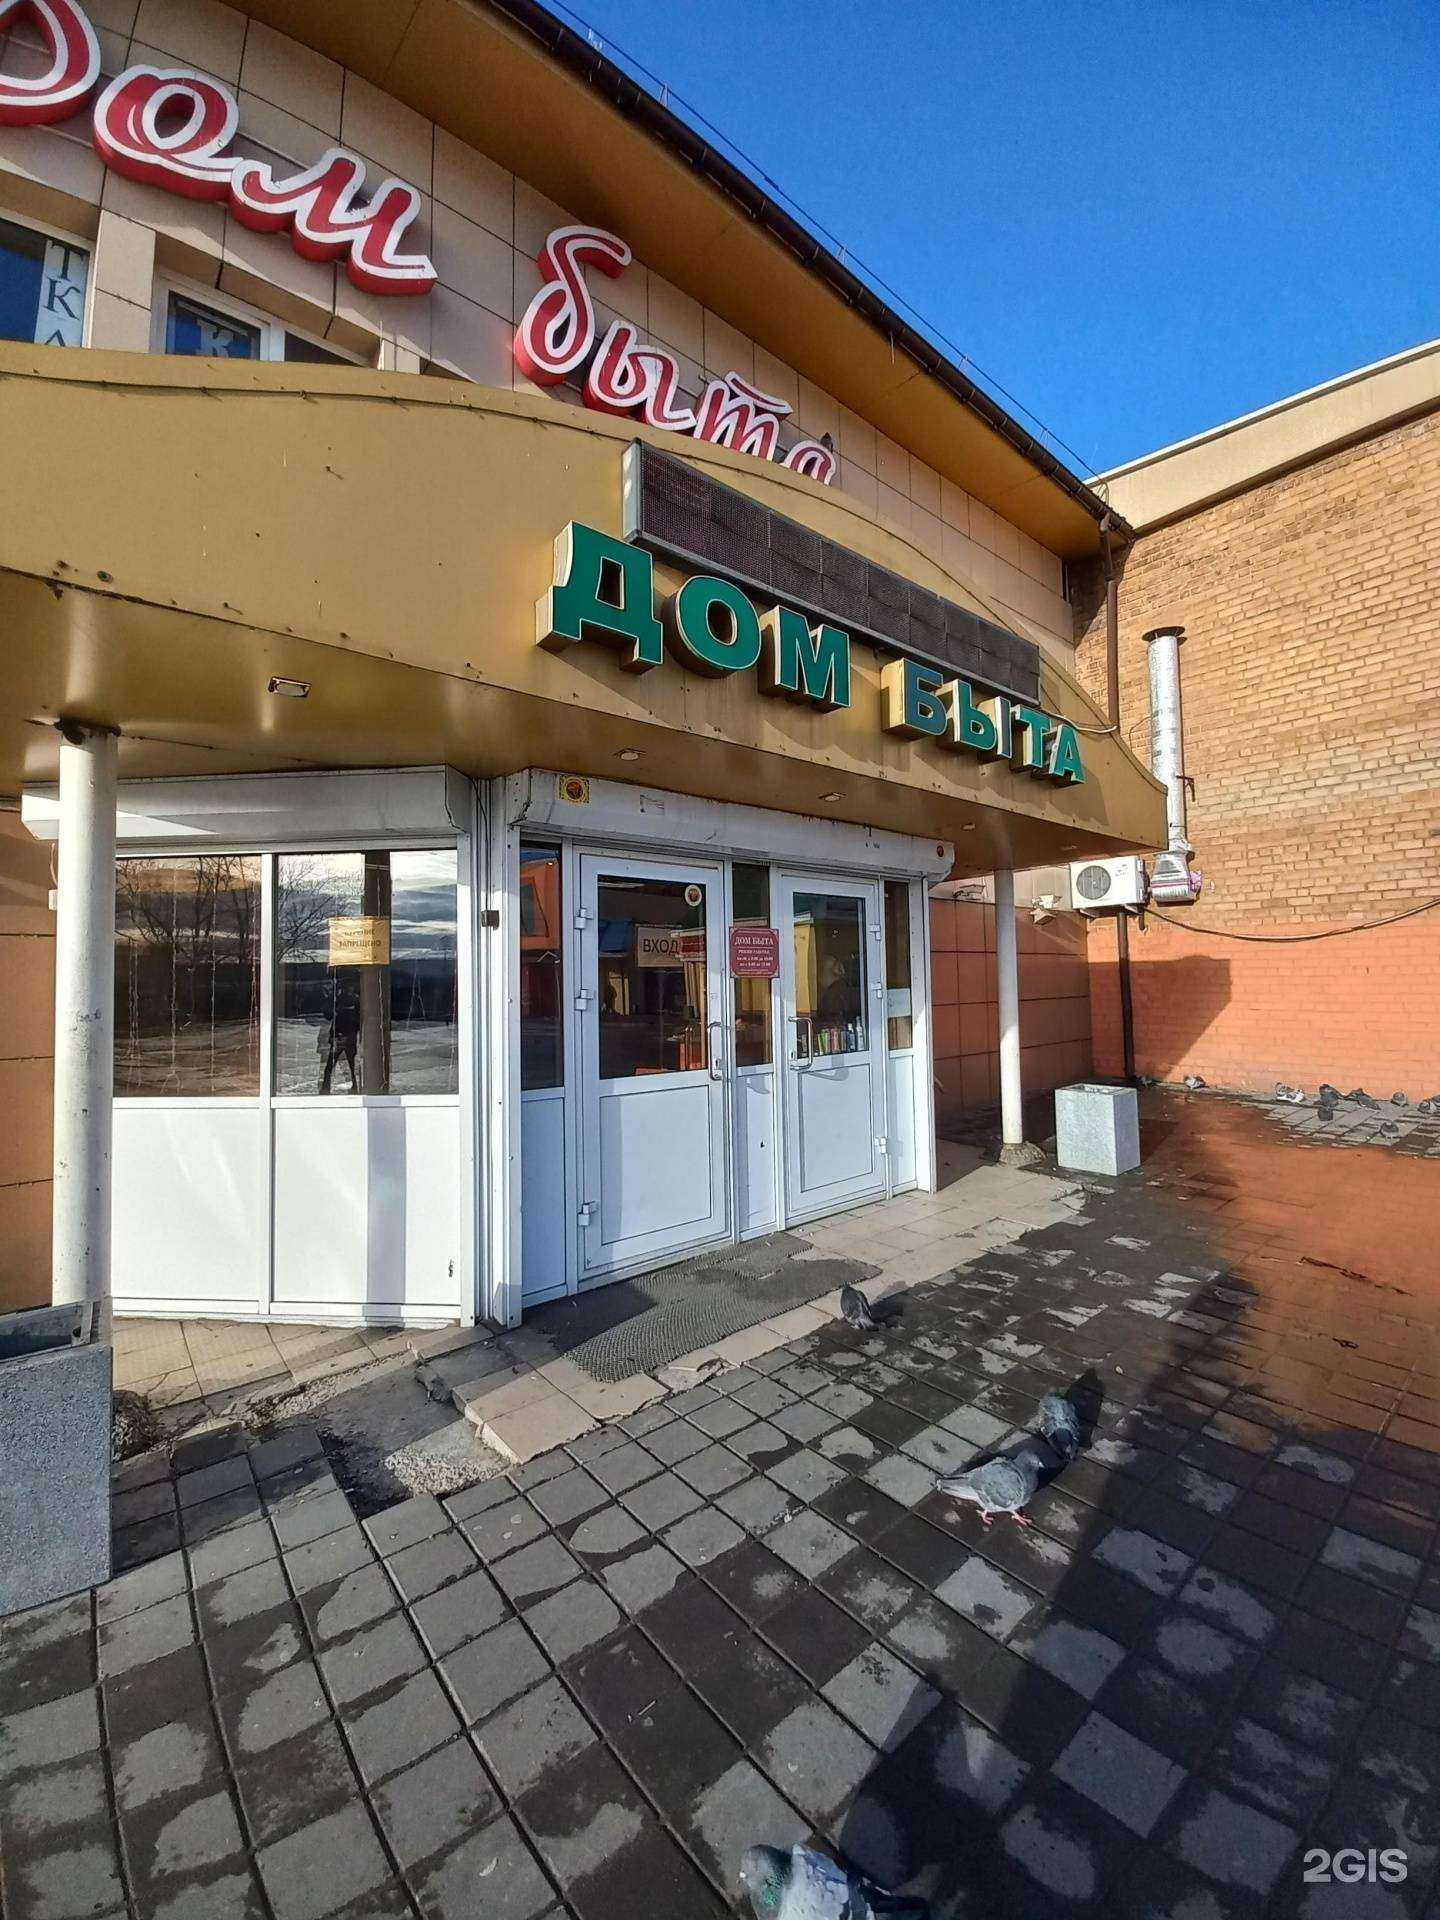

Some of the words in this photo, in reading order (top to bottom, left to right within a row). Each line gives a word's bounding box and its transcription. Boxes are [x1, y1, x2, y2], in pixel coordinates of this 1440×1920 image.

[540, 520, 851, 709] ДОМ
[890, 657, 1086, 785] БЫТА
[642, 938, 680, 955] ВХОД
[735, 936, 751, 946] ДОМ
[752, 936, 774, 946] БЫТА
